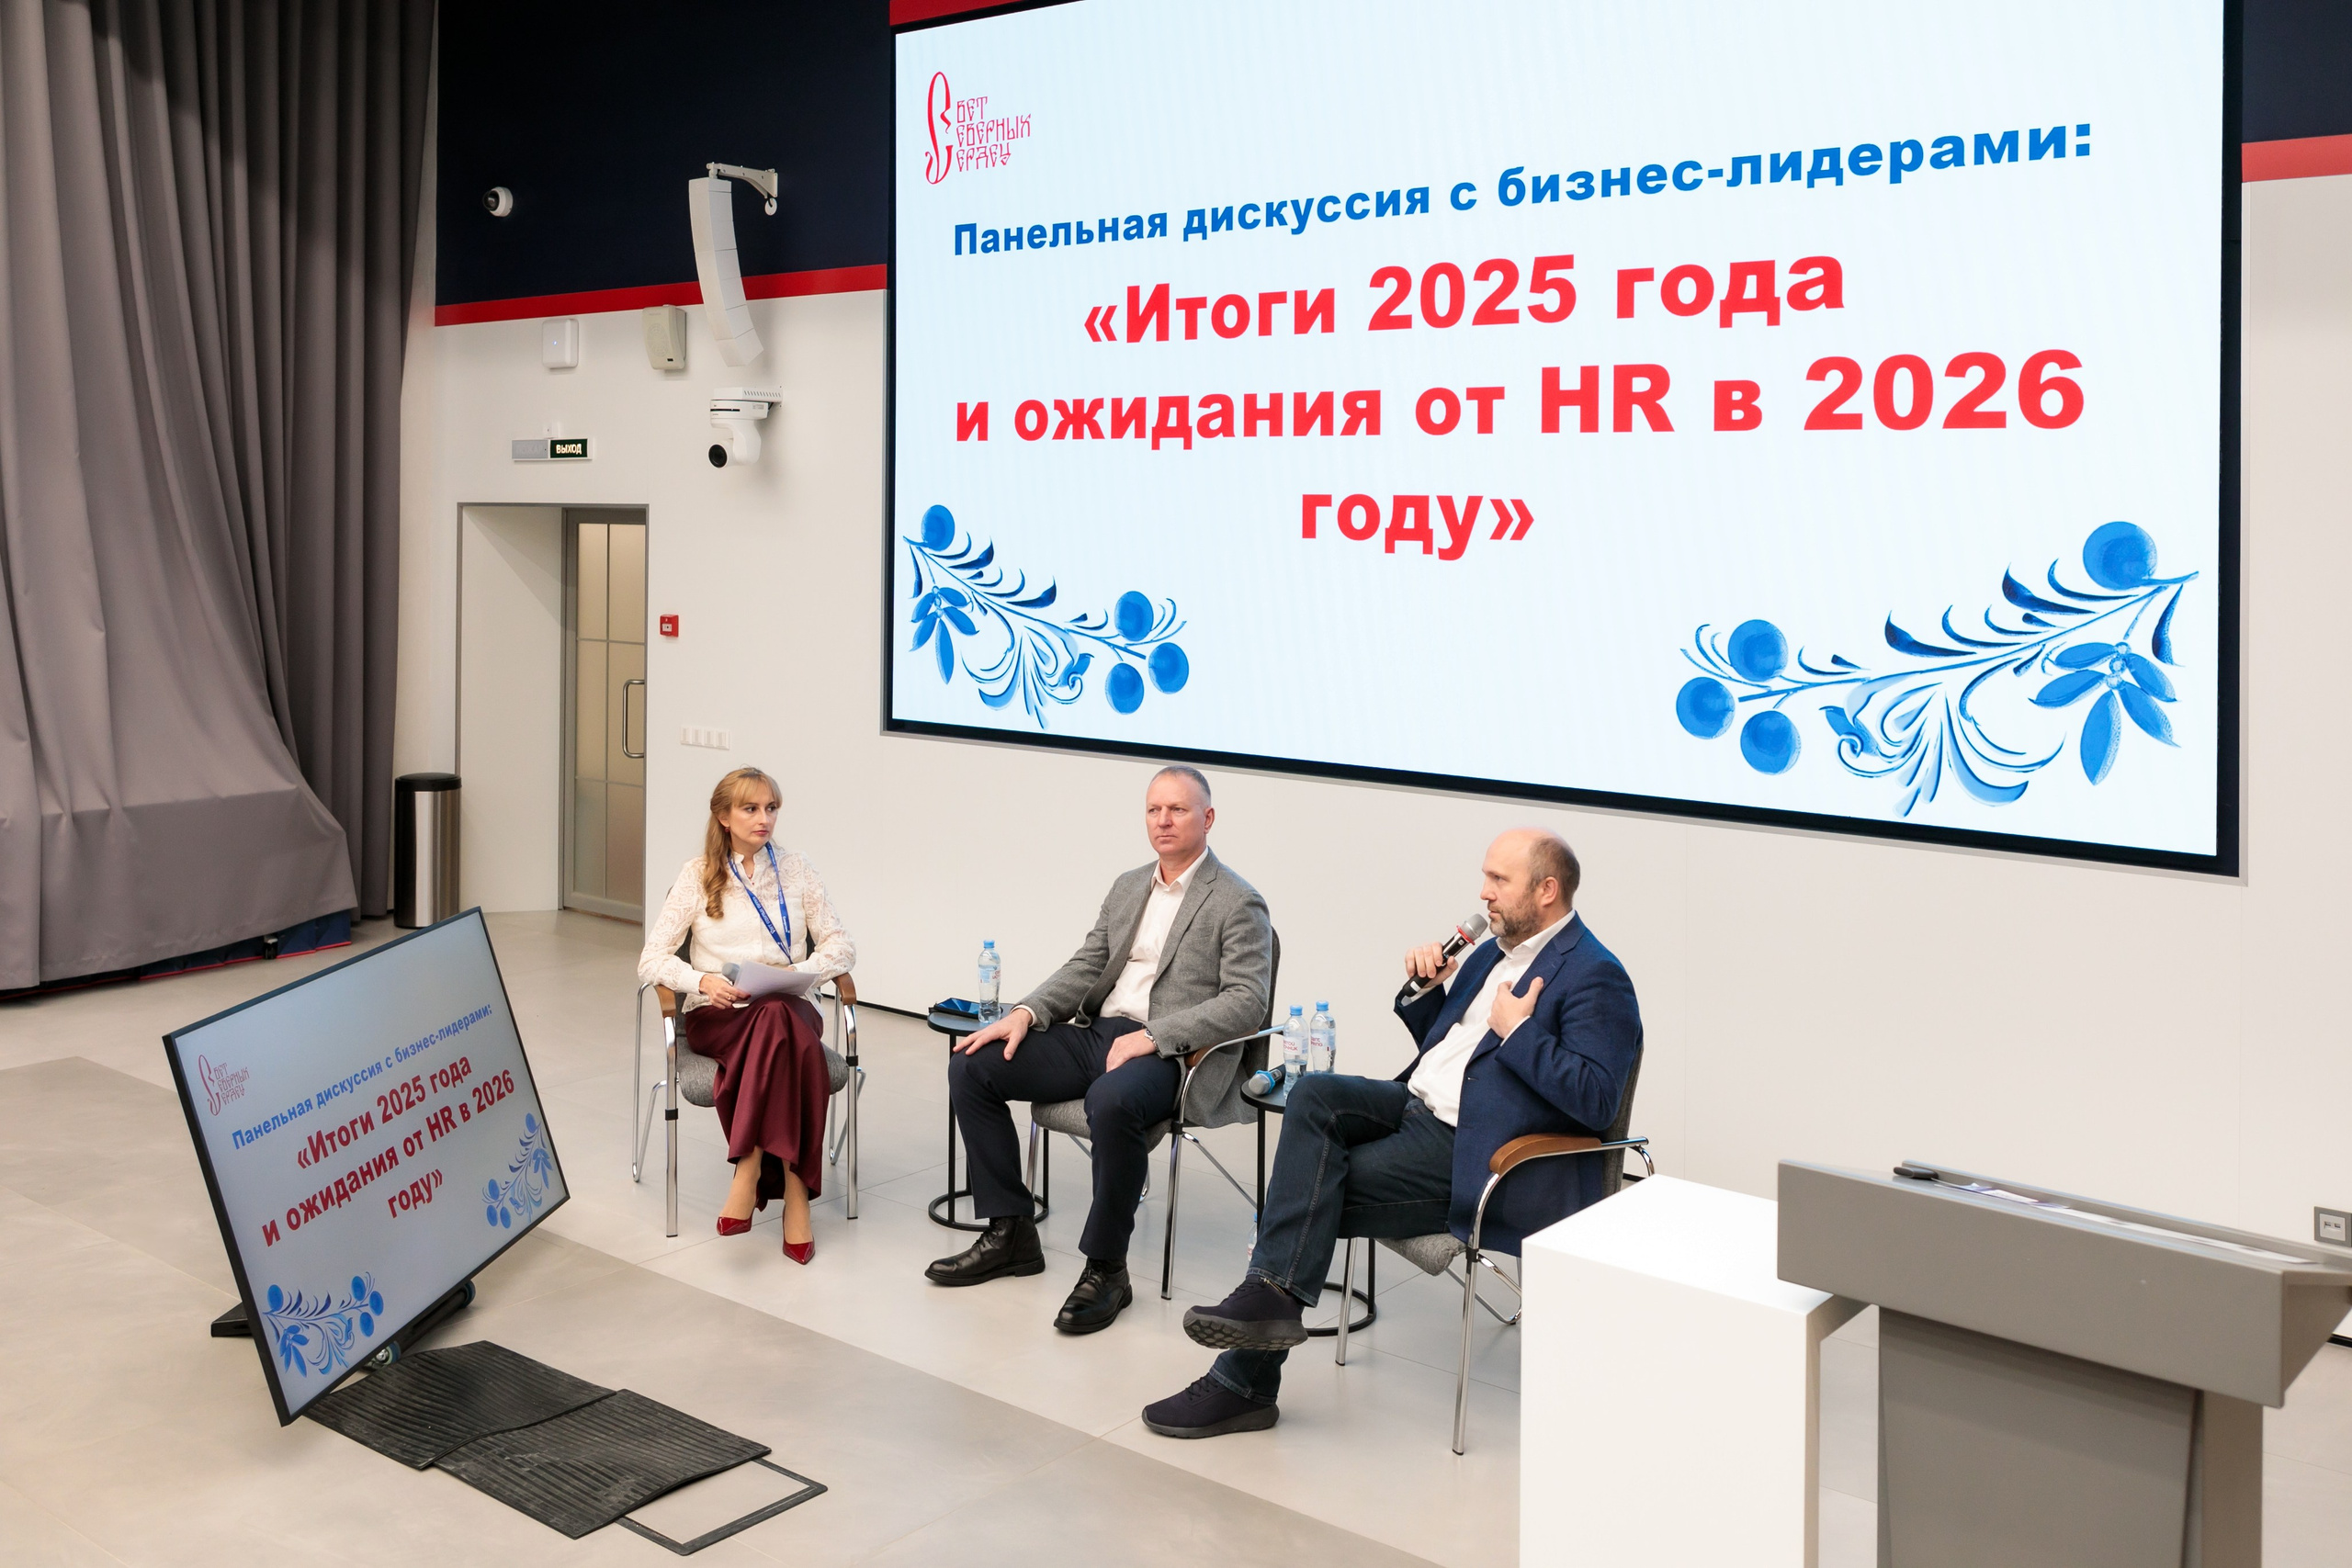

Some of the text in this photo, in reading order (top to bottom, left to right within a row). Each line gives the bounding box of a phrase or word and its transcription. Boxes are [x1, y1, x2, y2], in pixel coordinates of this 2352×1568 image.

[955, 123, 2091, 256] Панельная дискуссия с бизнес-лидерами:
[1083, 254, 1845, 344] «Итоги 2025 года
[556, 443, 582, 455] ВЫХОД
[956, 348, 2086, 451] и ожидания от HR в 2026
[1301, 493, 1535, 561] году»
[232, 1002, 492, 1150] Панельная дискуссия с бизнес-лидерами:
[298, 1056, 472, 1170] «Итоги 2025 года
[262, 1069, 514, 1247] и ожидания от HR в 2026
[387, 1168, 444, 1218] году»
